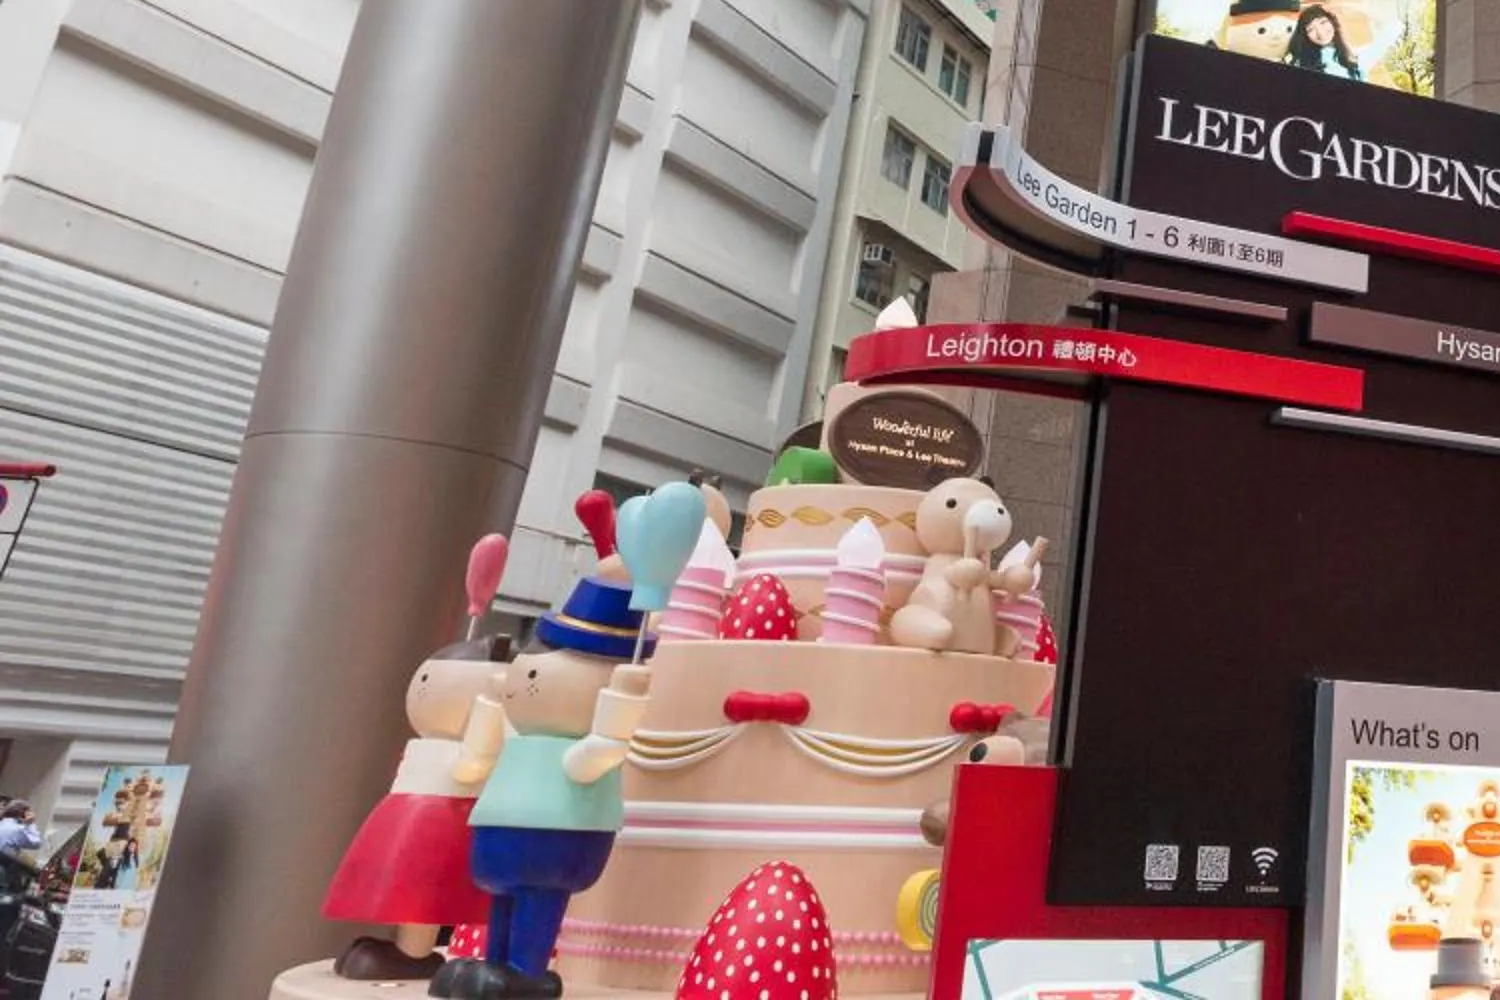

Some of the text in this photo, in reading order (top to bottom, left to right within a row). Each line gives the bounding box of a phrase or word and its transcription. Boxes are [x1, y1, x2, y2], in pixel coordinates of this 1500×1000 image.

[1017, 159, 1041, 197] Lee
[1045, 184, 1117, 235] Garden
[1126, 219, 1138, 240] 1
[1163, 225, 1180, 248] 6
[926, 333, 1137, 367] Leighton 禮頓中心
[1351, 719, 1479, 751] What's on
